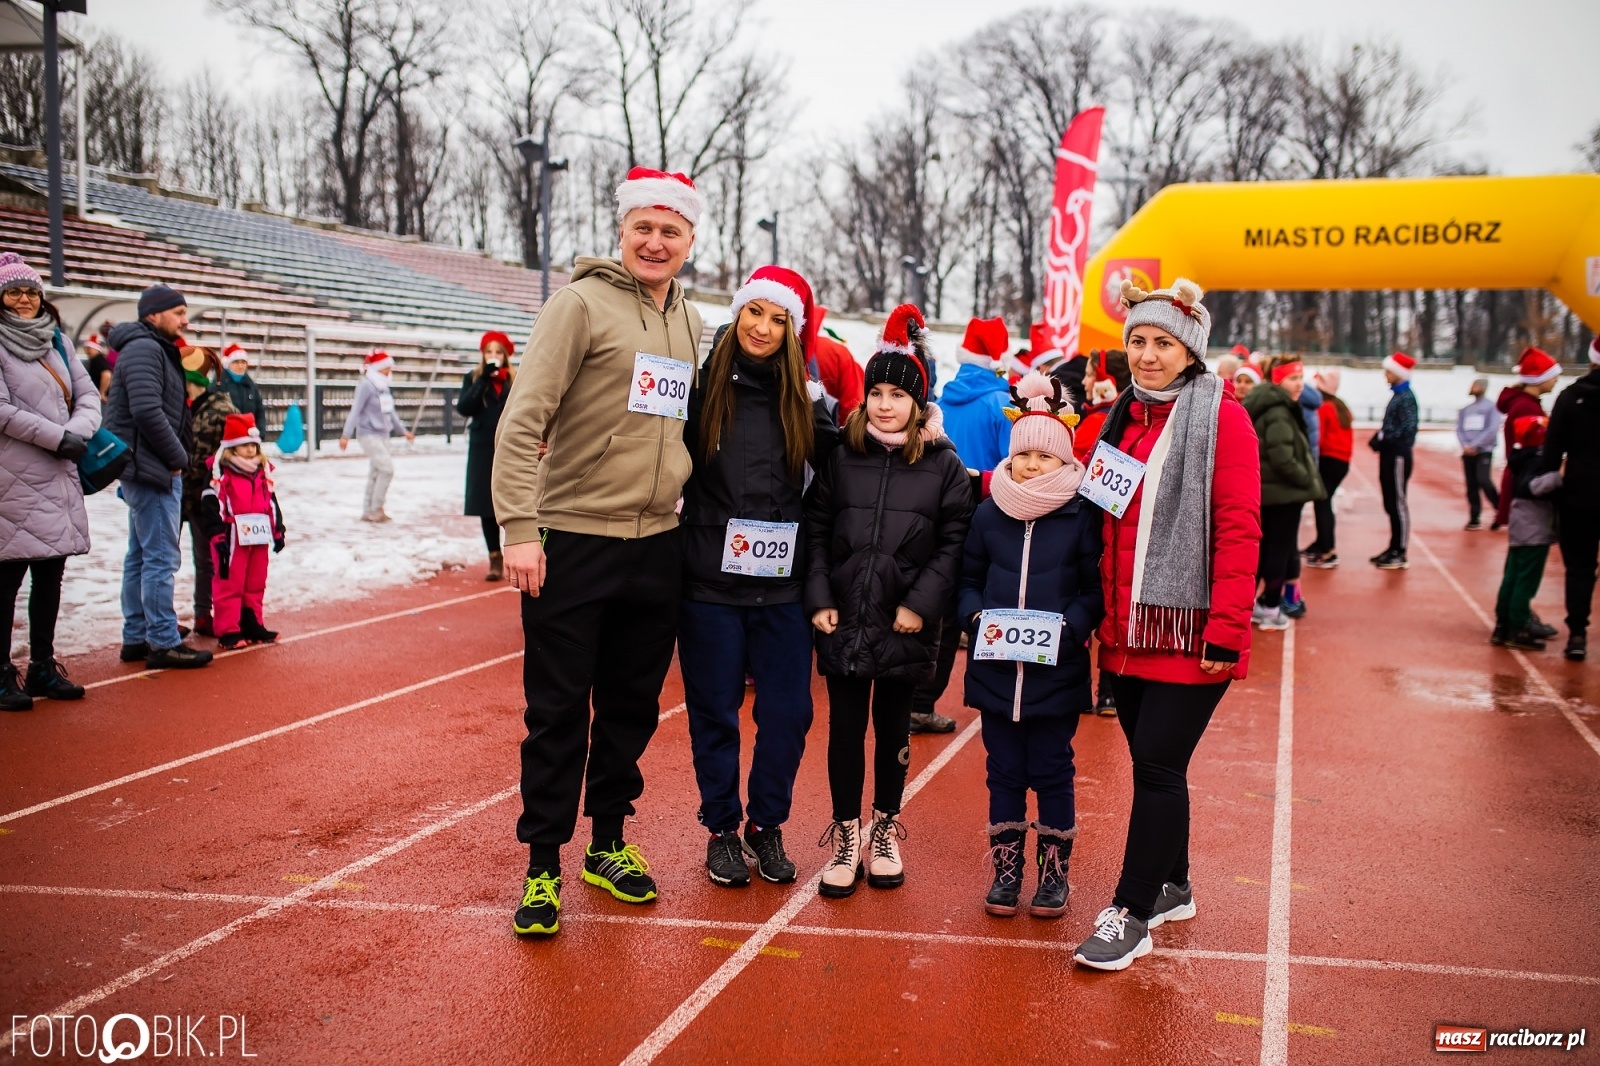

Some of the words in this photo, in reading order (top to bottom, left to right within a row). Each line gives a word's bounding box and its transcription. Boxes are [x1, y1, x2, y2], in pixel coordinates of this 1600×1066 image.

[1244, 227, 1345, 248] MIASTO
[1354, 217, 1502, 246] RACIBÓRZ
[657, 377, 686, 400] 030
[1101, 468, 1132, 497] 033
[751, 540, 789, 559] 029
[1005, 627, 1052, 648] 032
